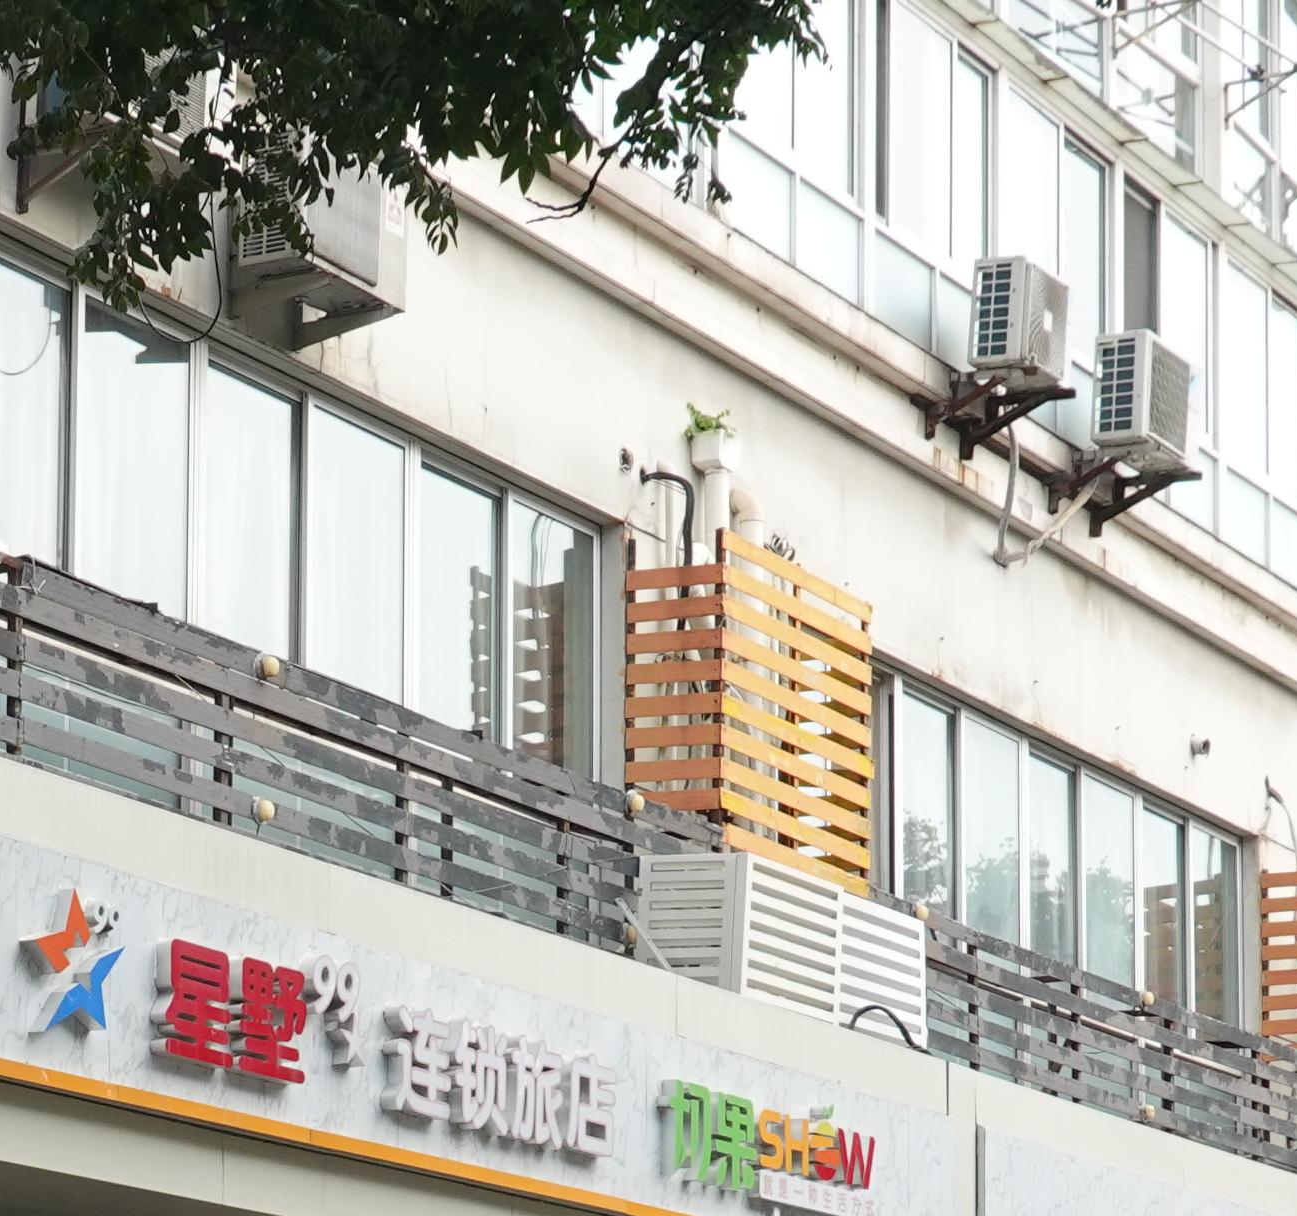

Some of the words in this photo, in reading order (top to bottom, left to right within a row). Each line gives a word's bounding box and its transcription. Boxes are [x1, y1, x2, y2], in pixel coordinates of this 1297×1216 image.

[155, 938, 307, 1084] 星墅
[303, 953, 361, 1020] 99
[383, 1002, 617, 1159] 连锁旅店
